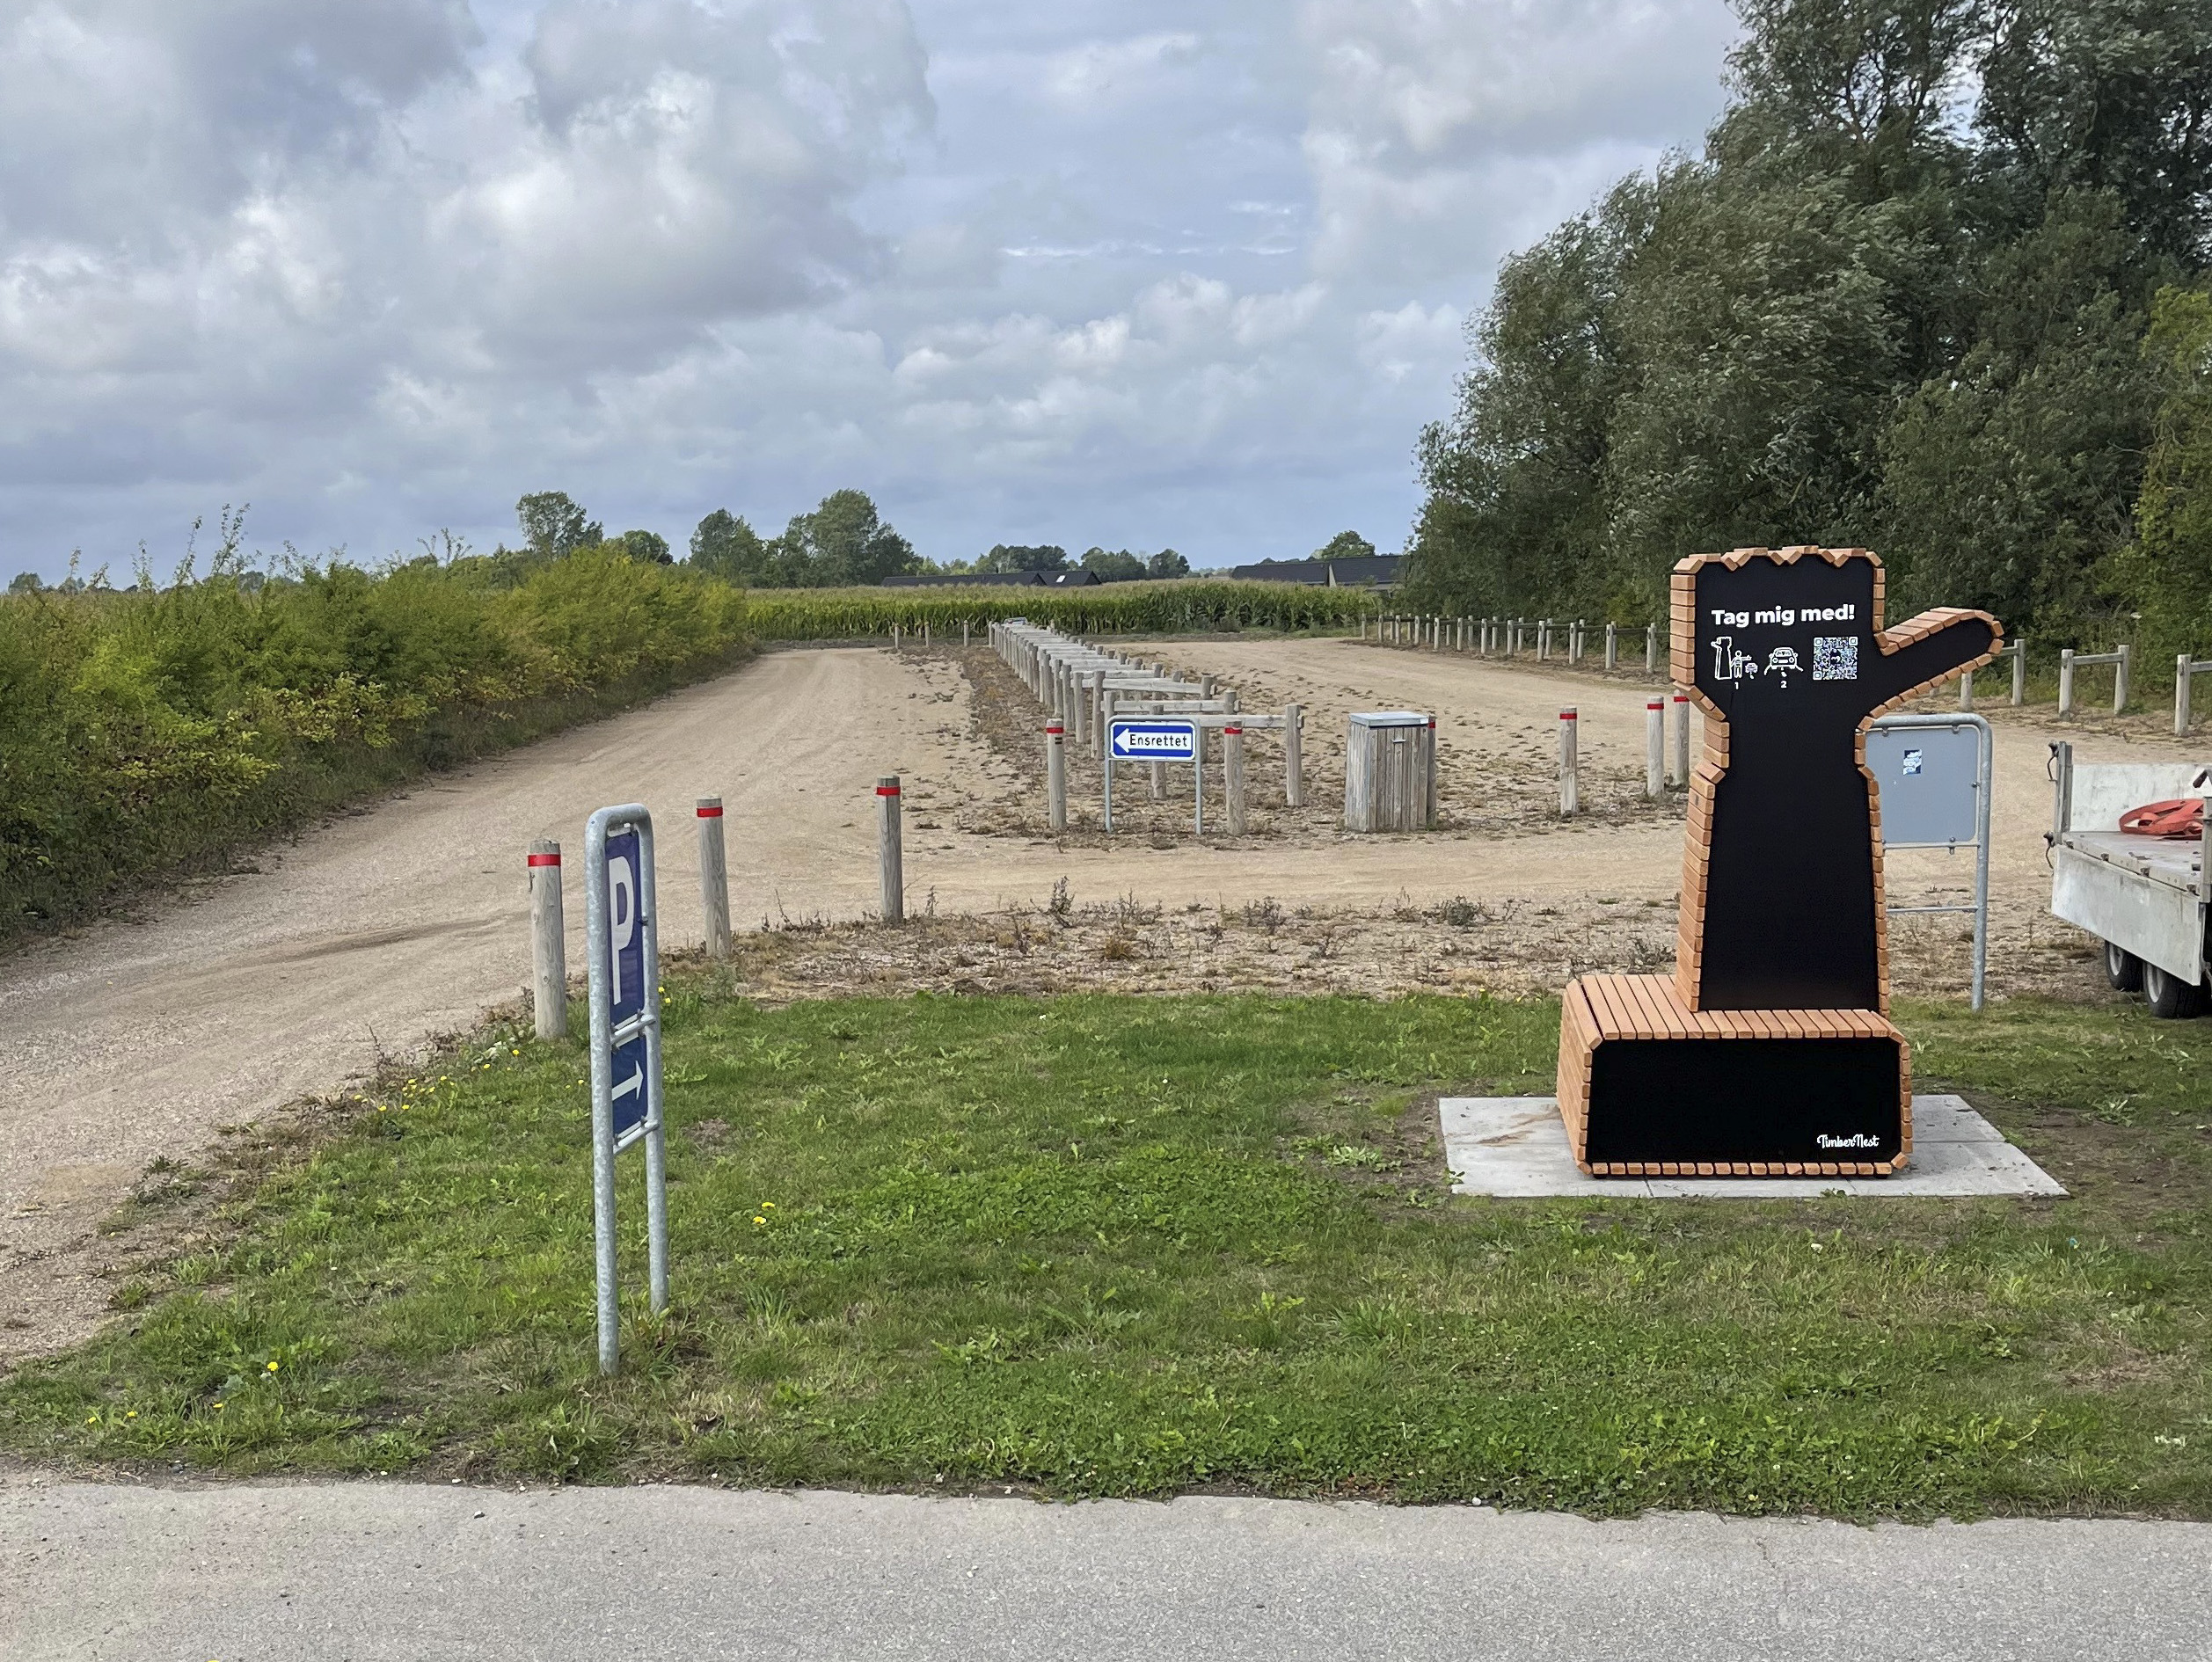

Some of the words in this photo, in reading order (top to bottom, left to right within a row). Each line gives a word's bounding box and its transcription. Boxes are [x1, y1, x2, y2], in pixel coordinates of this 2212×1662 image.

[1711, 609, 1750, 629] Tag
[1755, 605, 1795, 626] mig
[1800, 603, 1855, 622] med!
[1734, 682, 1739, 690] 1
[1780, 680, 1787, 689] 2
[1129, 733, 1187, 747] Ensrettet
[609, 856, 635, 1006] P
[1816, 1134, 1880, 1149] TimberNest
